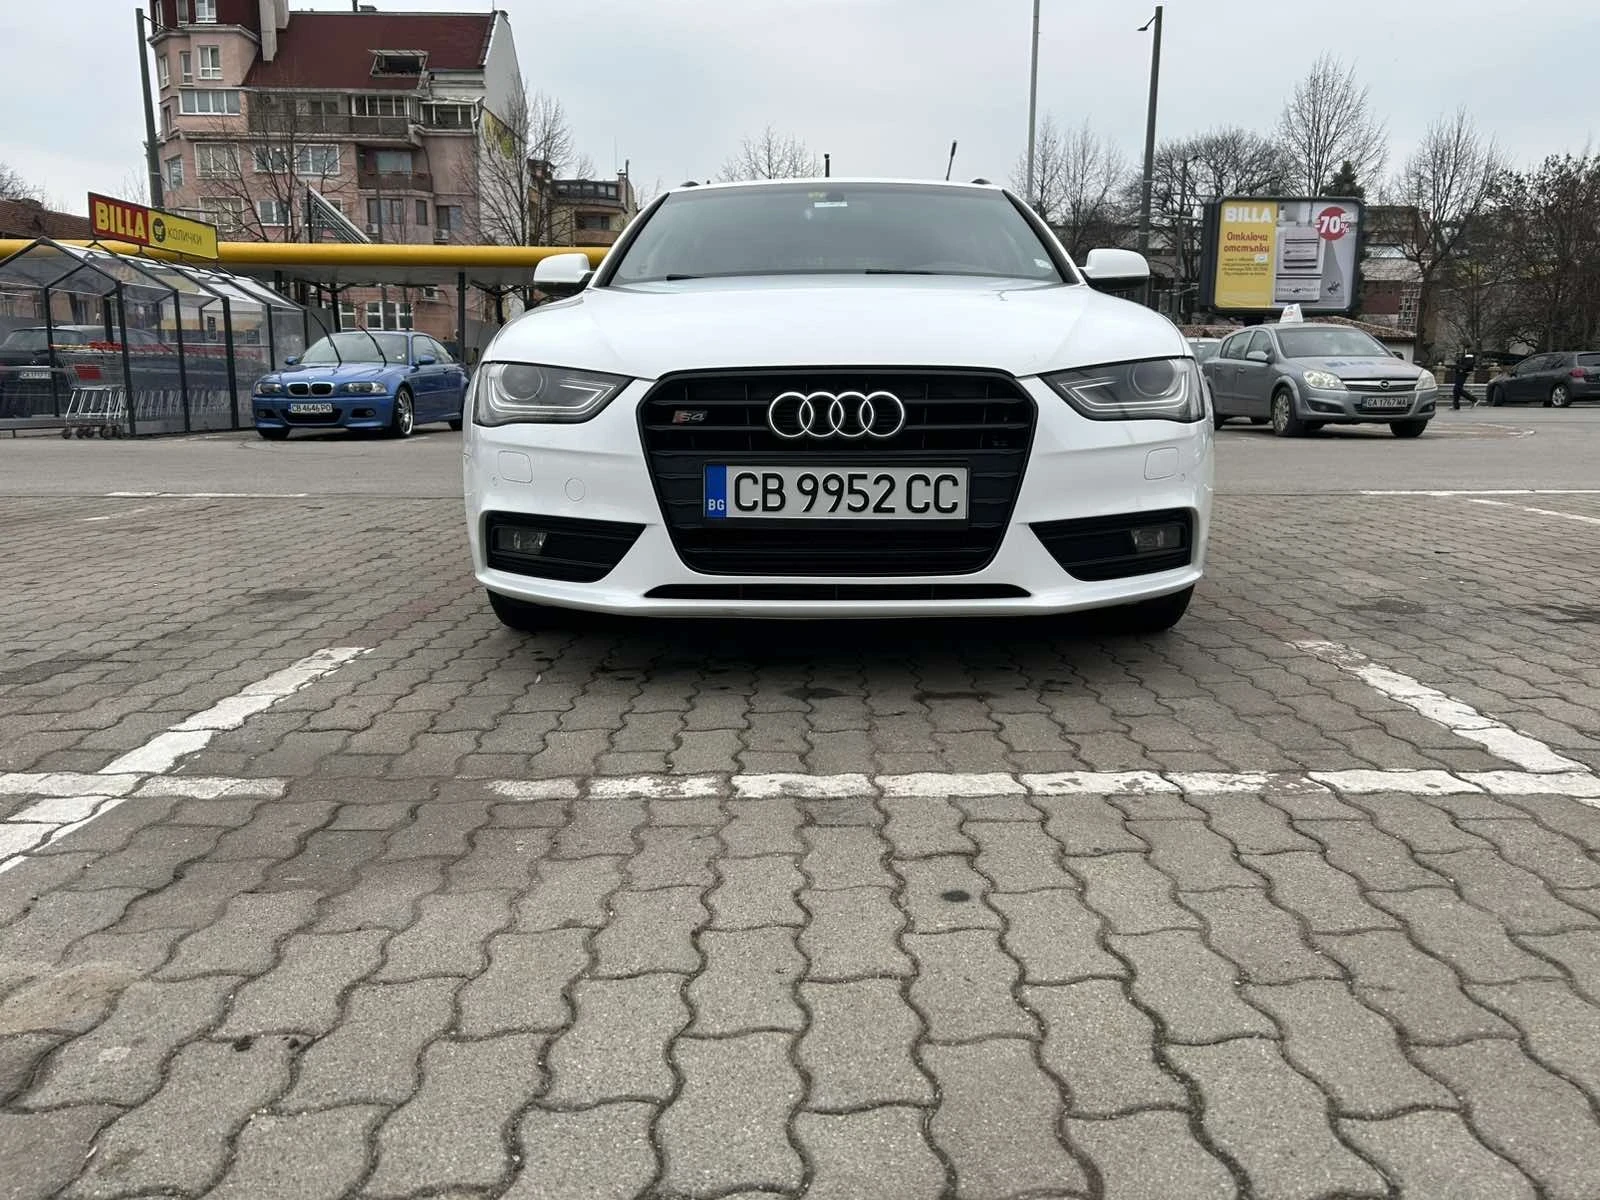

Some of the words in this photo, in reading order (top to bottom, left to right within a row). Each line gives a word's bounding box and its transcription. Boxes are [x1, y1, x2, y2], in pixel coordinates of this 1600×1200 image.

[95, 201, 147, 239] BILLA
[1224, 207, 1272, 223] BILLA
[167, 227, 202, 245] КОЛИЧКИ
[1226, 231, 1268, 241] Отключи
[1223, 242, 1269, 253] отстъпки
[676, 411, 706, 422] S4
[734, 472, 786, 512] CB
[796, 472, 896, 513] 9952
[905, 473, 959, 513] CC
[708, 499, 725, 511] BG
